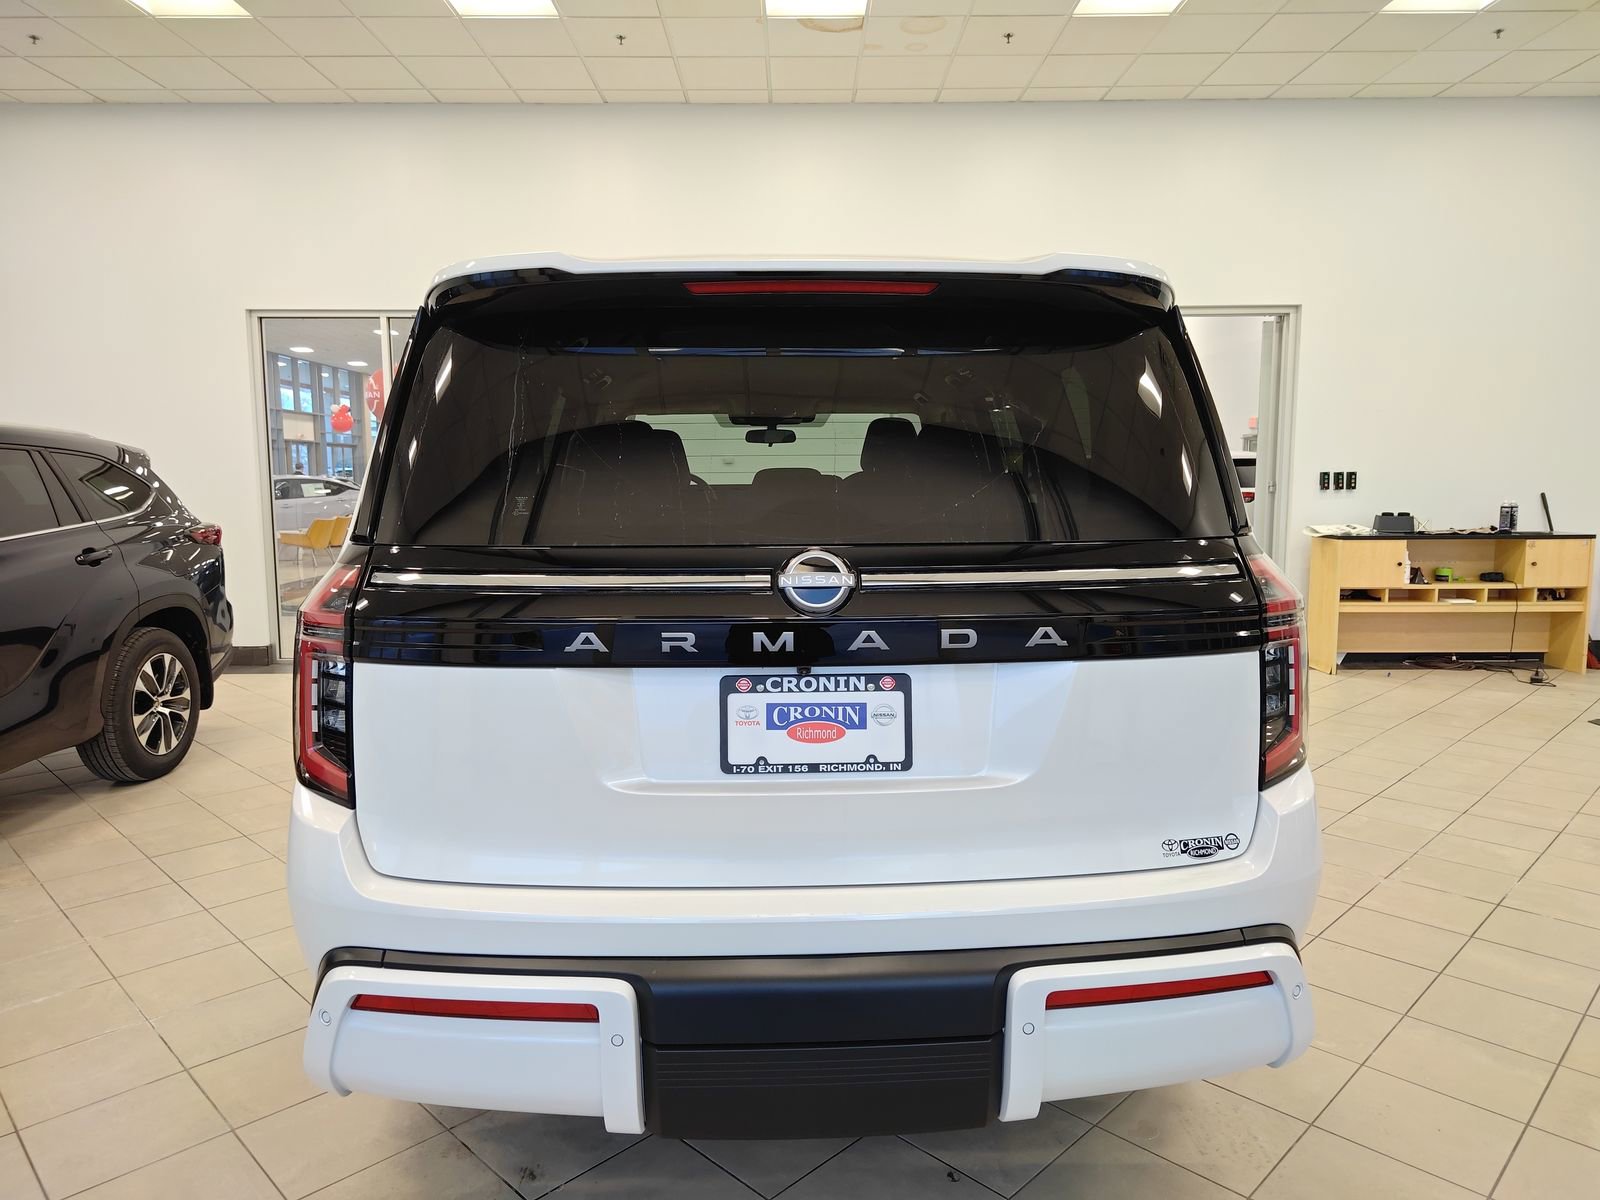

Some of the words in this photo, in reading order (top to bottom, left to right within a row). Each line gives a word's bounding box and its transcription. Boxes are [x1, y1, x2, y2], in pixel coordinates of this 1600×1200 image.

[780, 575, 853, 586] NISSAN
[564, 626, 1068, 653] ARMADA
[765, 676, 866, 692] CRONIN
[773, 705, 860, 726] CRONIN
[796, 727, 837, 740] Richmond
[733, 765, 755, 773] I-70
[758, 765, 784, 773] EXIT
[889, 763, 902, 771] IN
[1181, 836, 1223, 851] CRONIN
[1190, 848, 1216, 856] RICHMOND
